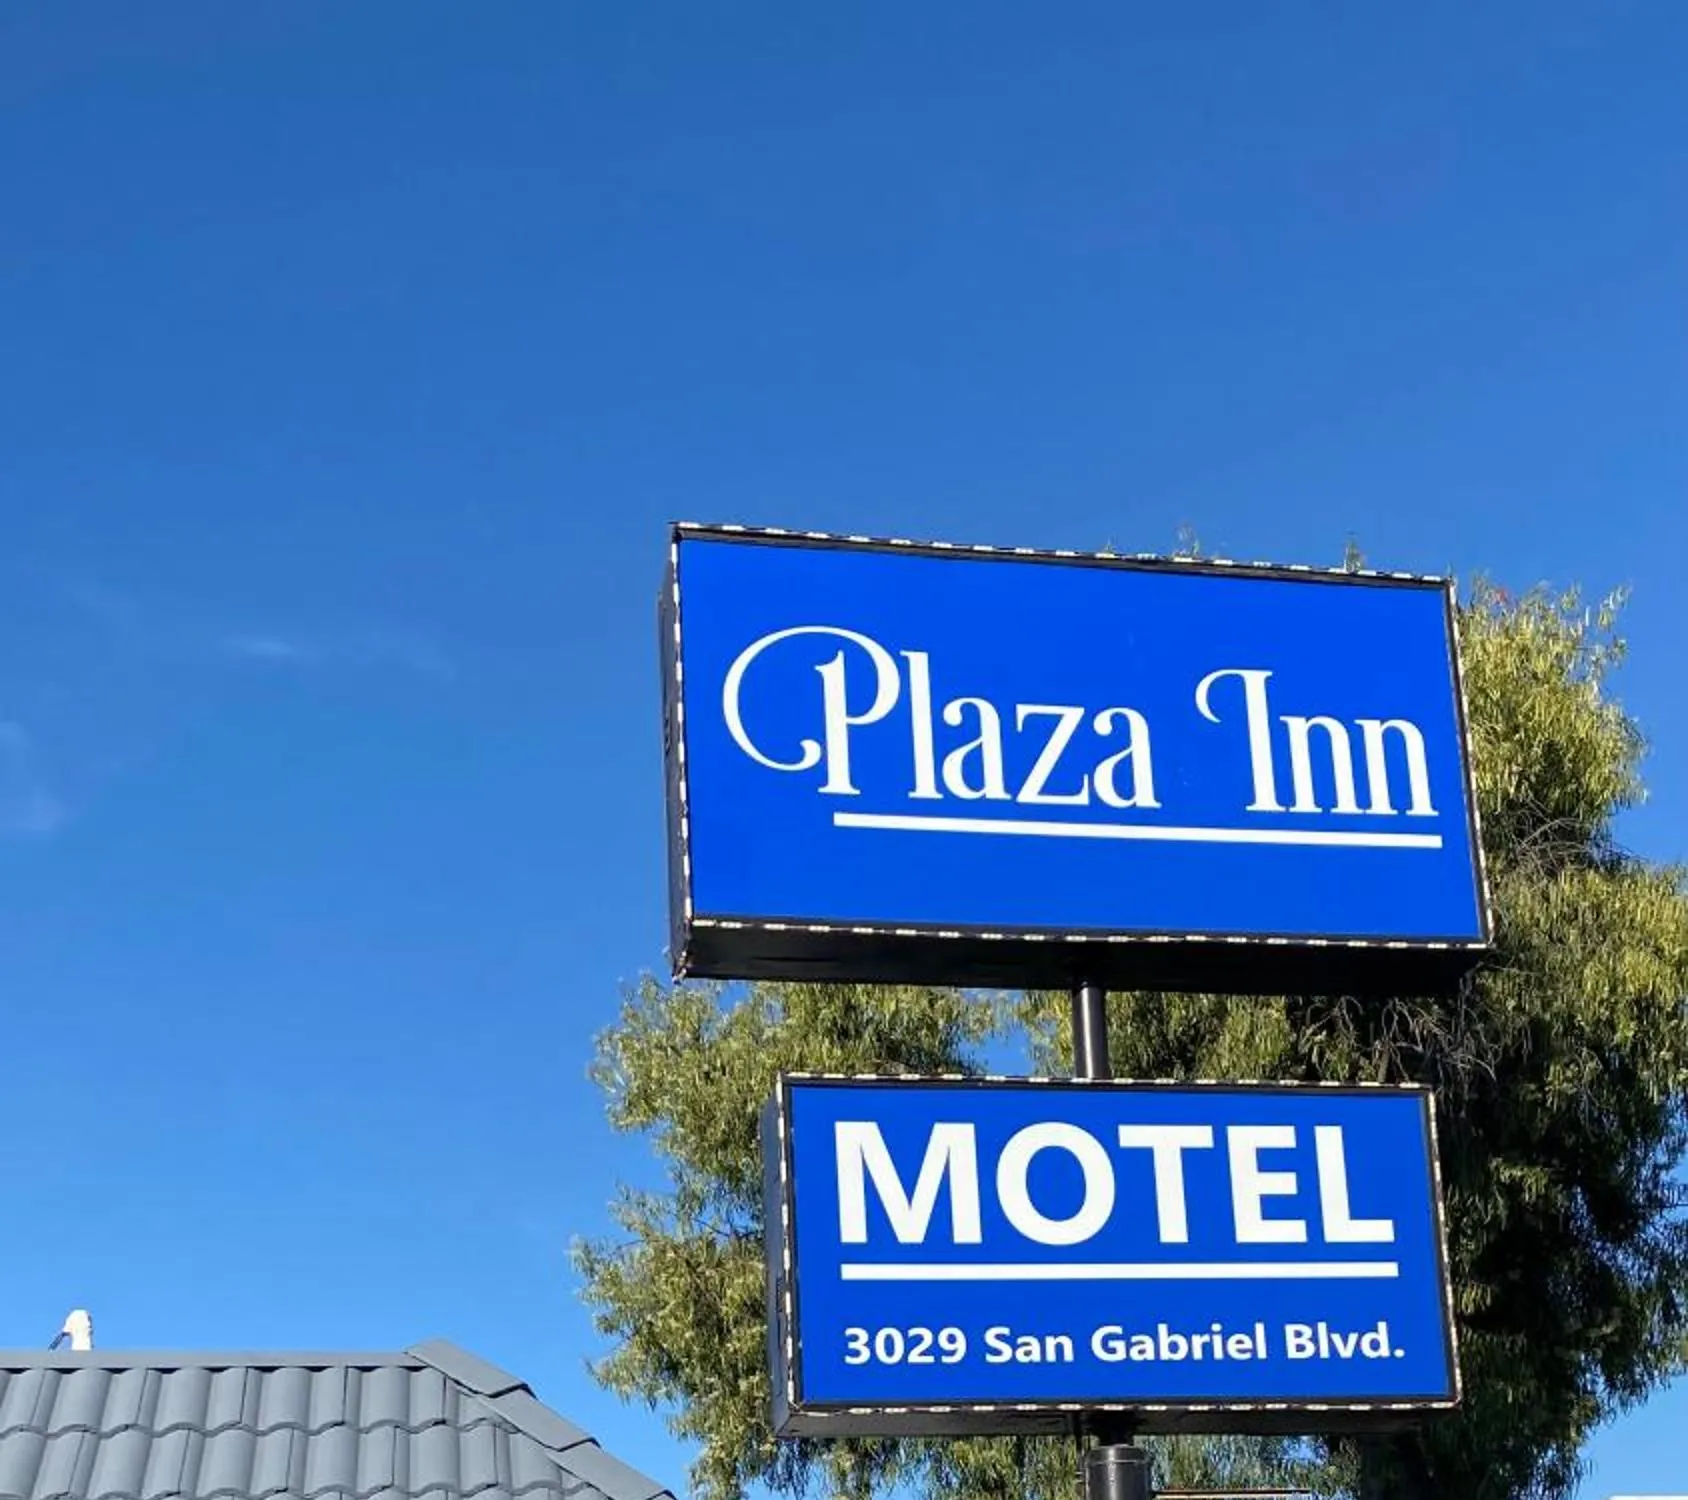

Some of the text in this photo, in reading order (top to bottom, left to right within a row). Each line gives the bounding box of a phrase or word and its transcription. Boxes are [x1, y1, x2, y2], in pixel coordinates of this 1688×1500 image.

[722, 626, 1440, 816] Plaza Inn
[835, 1121, 1396, 1246] MOTEL
[845, 1321, 1405, 1365] 3029 San Gabriel Blvd.
